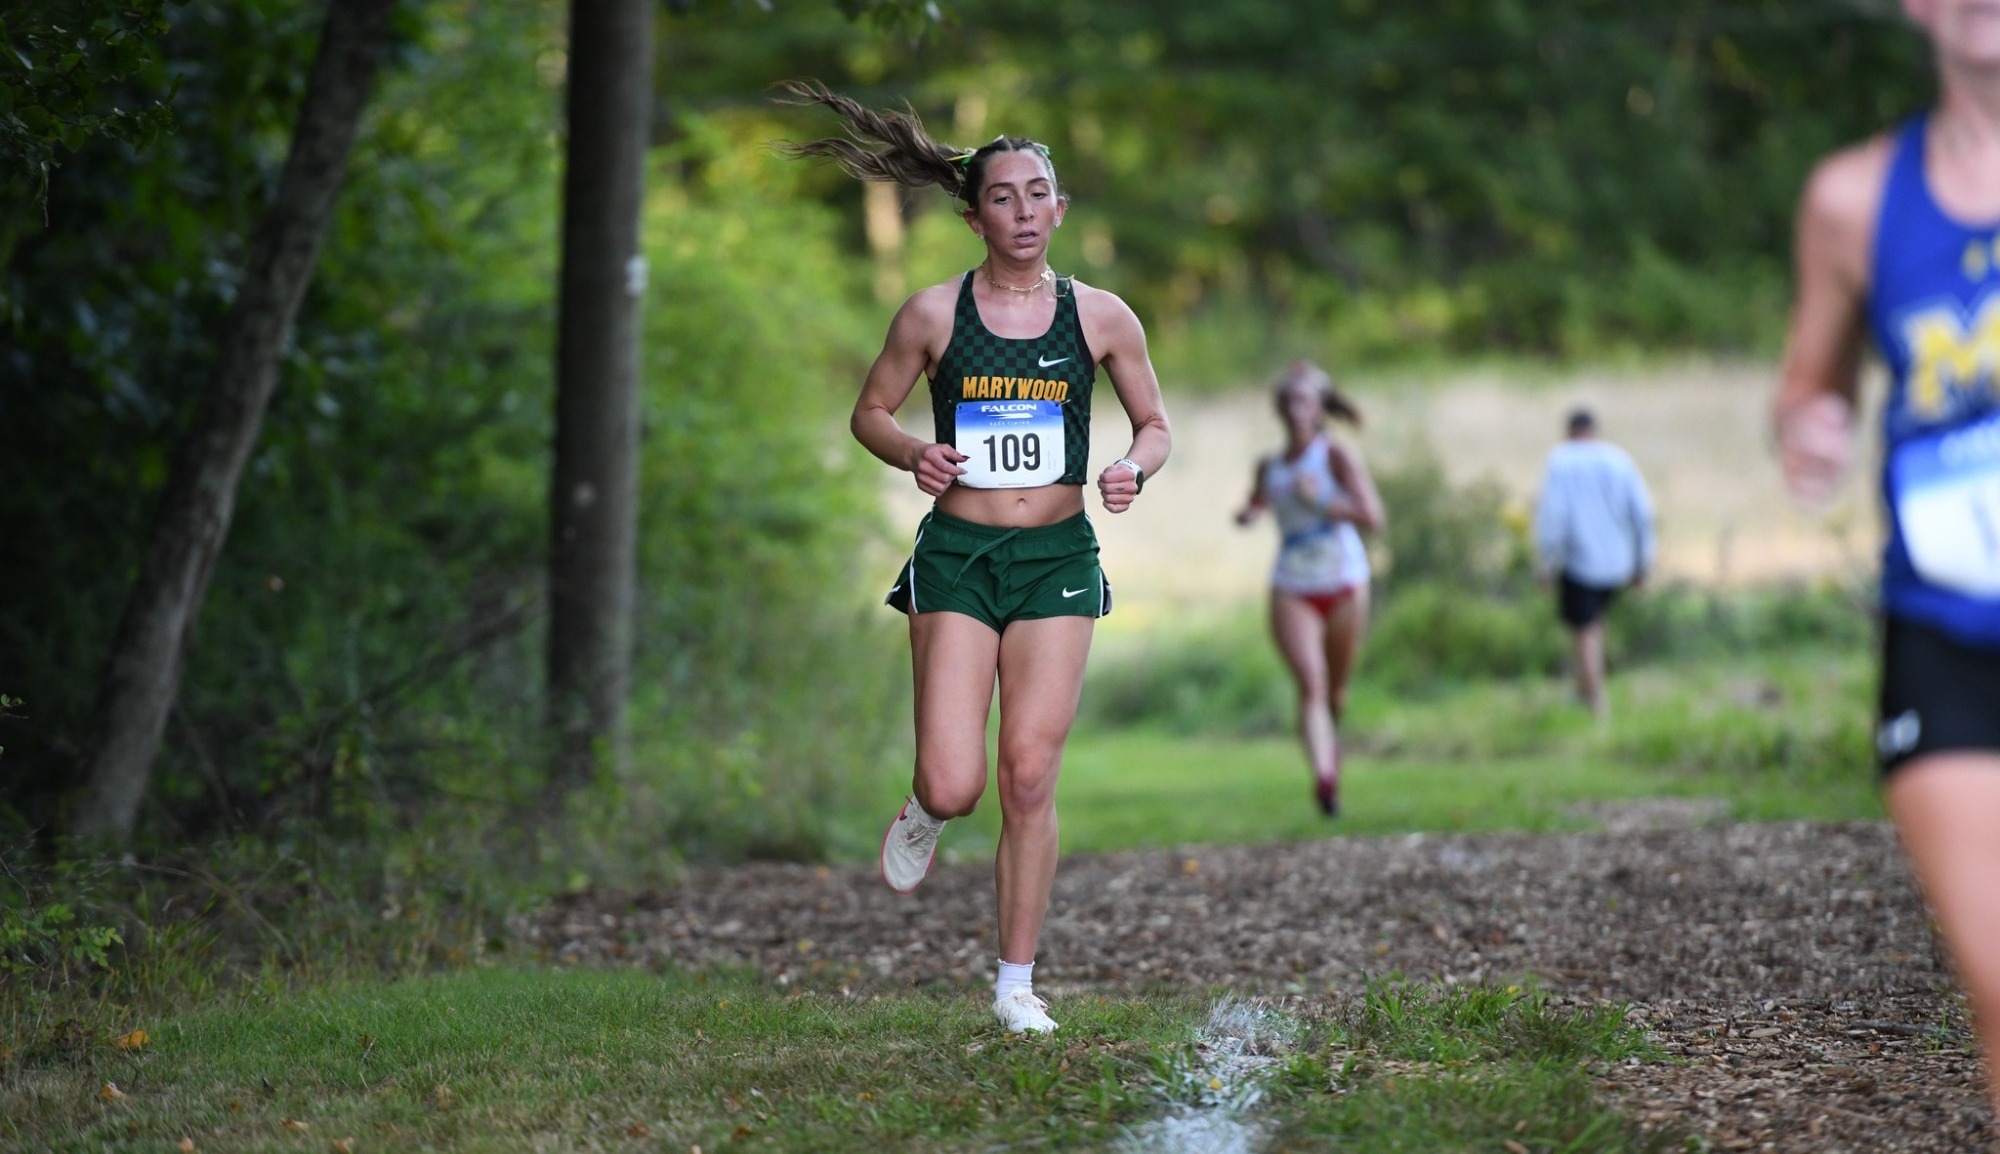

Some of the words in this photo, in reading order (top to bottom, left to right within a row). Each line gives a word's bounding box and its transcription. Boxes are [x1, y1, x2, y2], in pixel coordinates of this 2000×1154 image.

[963, 376, 1069, 402] MARYWOOD
[981, 403, 1037, 413] FALCON
[983, 433, 1041, 472] 109
